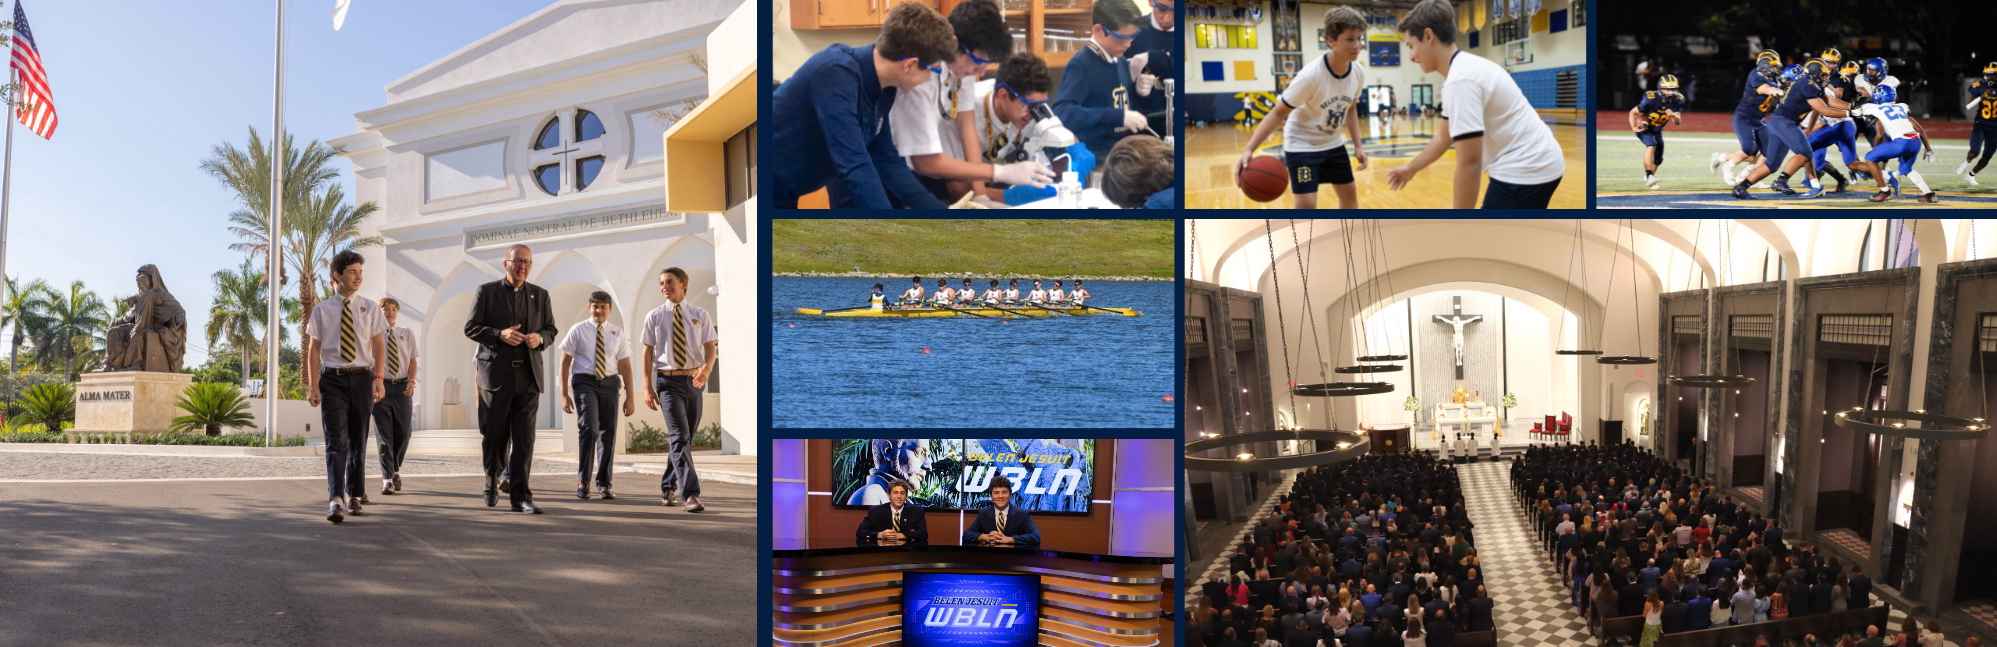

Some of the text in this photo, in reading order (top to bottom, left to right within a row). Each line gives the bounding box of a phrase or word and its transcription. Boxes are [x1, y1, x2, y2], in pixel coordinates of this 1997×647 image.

[80, 390, 131, 401] ALMA MATER
[934, 596, 964, 605] BELEN
